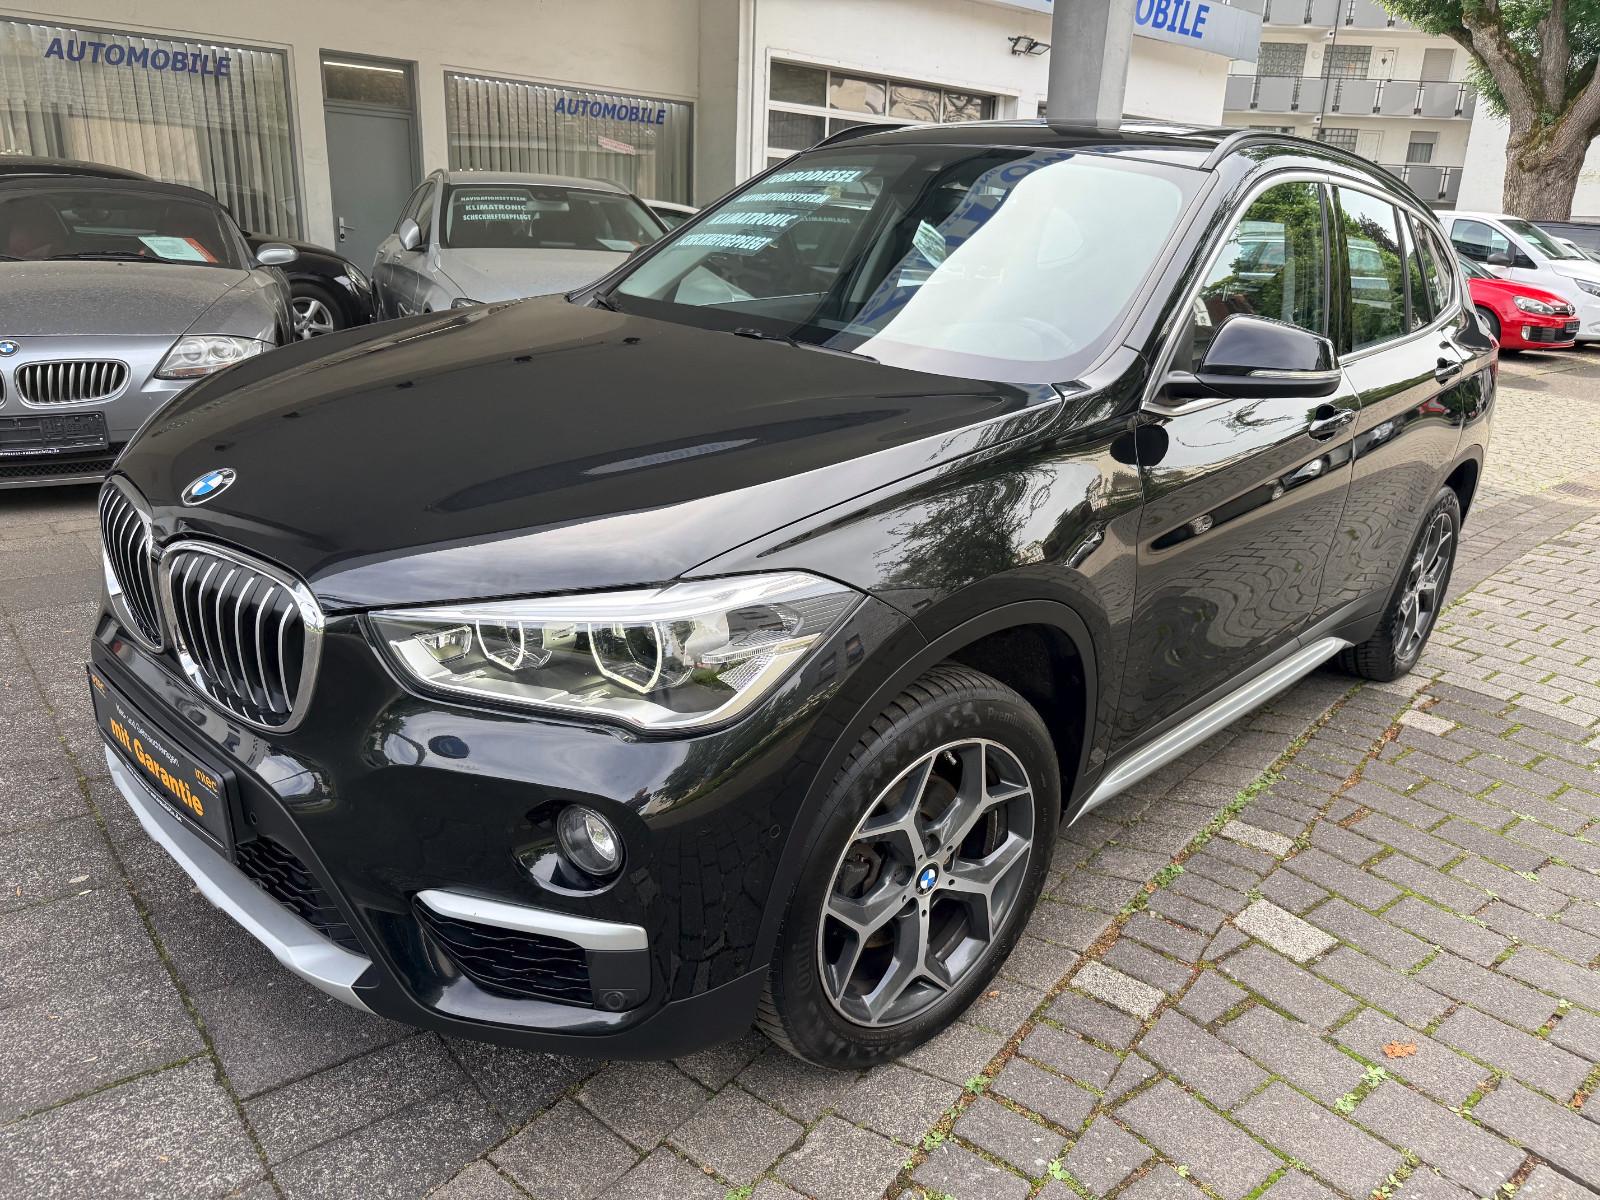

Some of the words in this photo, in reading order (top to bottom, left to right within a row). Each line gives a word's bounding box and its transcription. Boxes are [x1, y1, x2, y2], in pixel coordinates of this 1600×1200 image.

[44, 37, 232, 77] AUTOMOBILE
[554, 97, 666, 125] AUTOMOBILE
[465, 203, 528, 211] KLIMATRONIC
[110, 717, 132, 753] mit
[133, 738, 204, 817] Garantie
